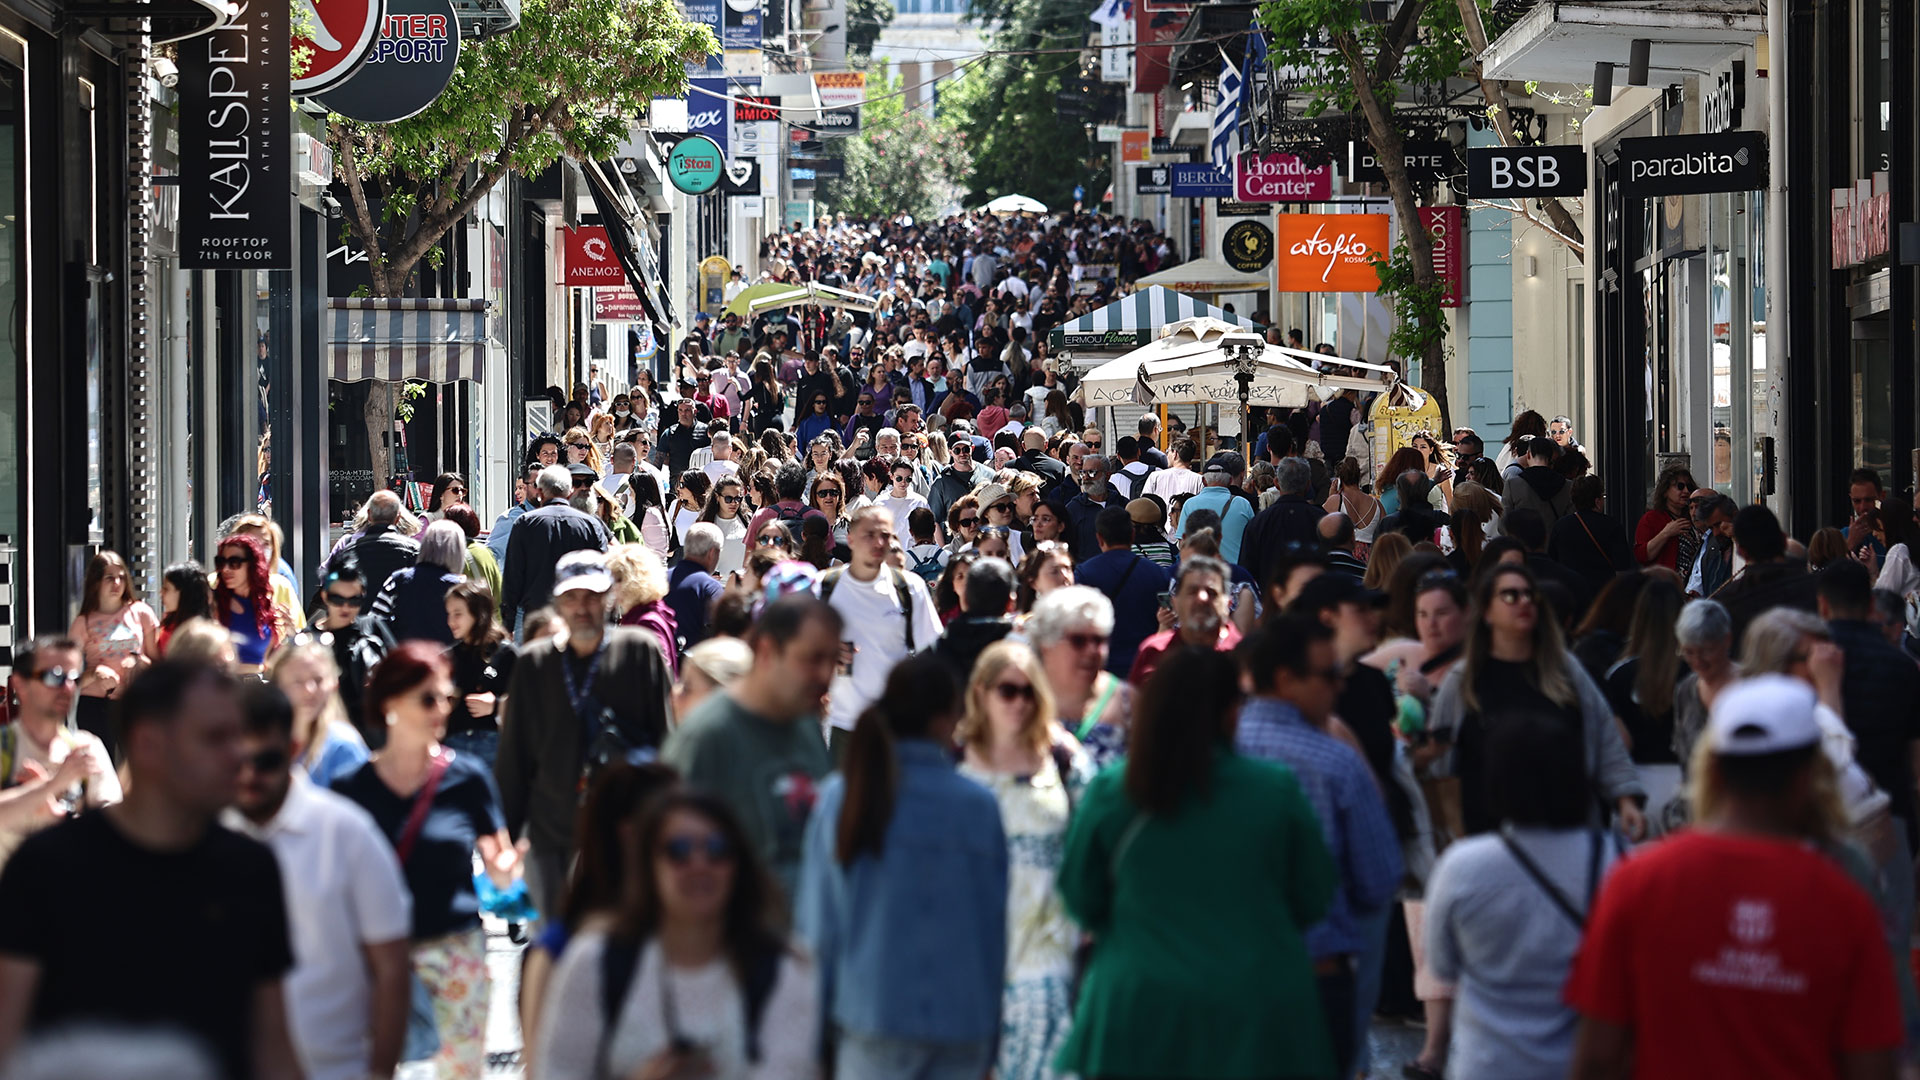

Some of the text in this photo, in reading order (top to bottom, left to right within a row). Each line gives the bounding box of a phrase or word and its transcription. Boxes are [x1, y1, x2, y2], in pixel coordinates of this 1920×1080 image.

[381, 14, 448, 38] NTER
[260, 11, 270, 172] ATHENIAN TAPAS
[680, 157, 712, 169] iStoa
[1632, 151, 1733, 182] parabita
[1491, 156, 1560, 189] BSB
[1245, 175, 1316, 196] Center
[202, 238, 269, 247] ROOFTOP
[199, 251, 272, 260] 7th FLOOR
[570, 267, 620, 277] ΑΝΕΜΟΣ
[1064, 331, 1138, 345] ERMOU Flower
